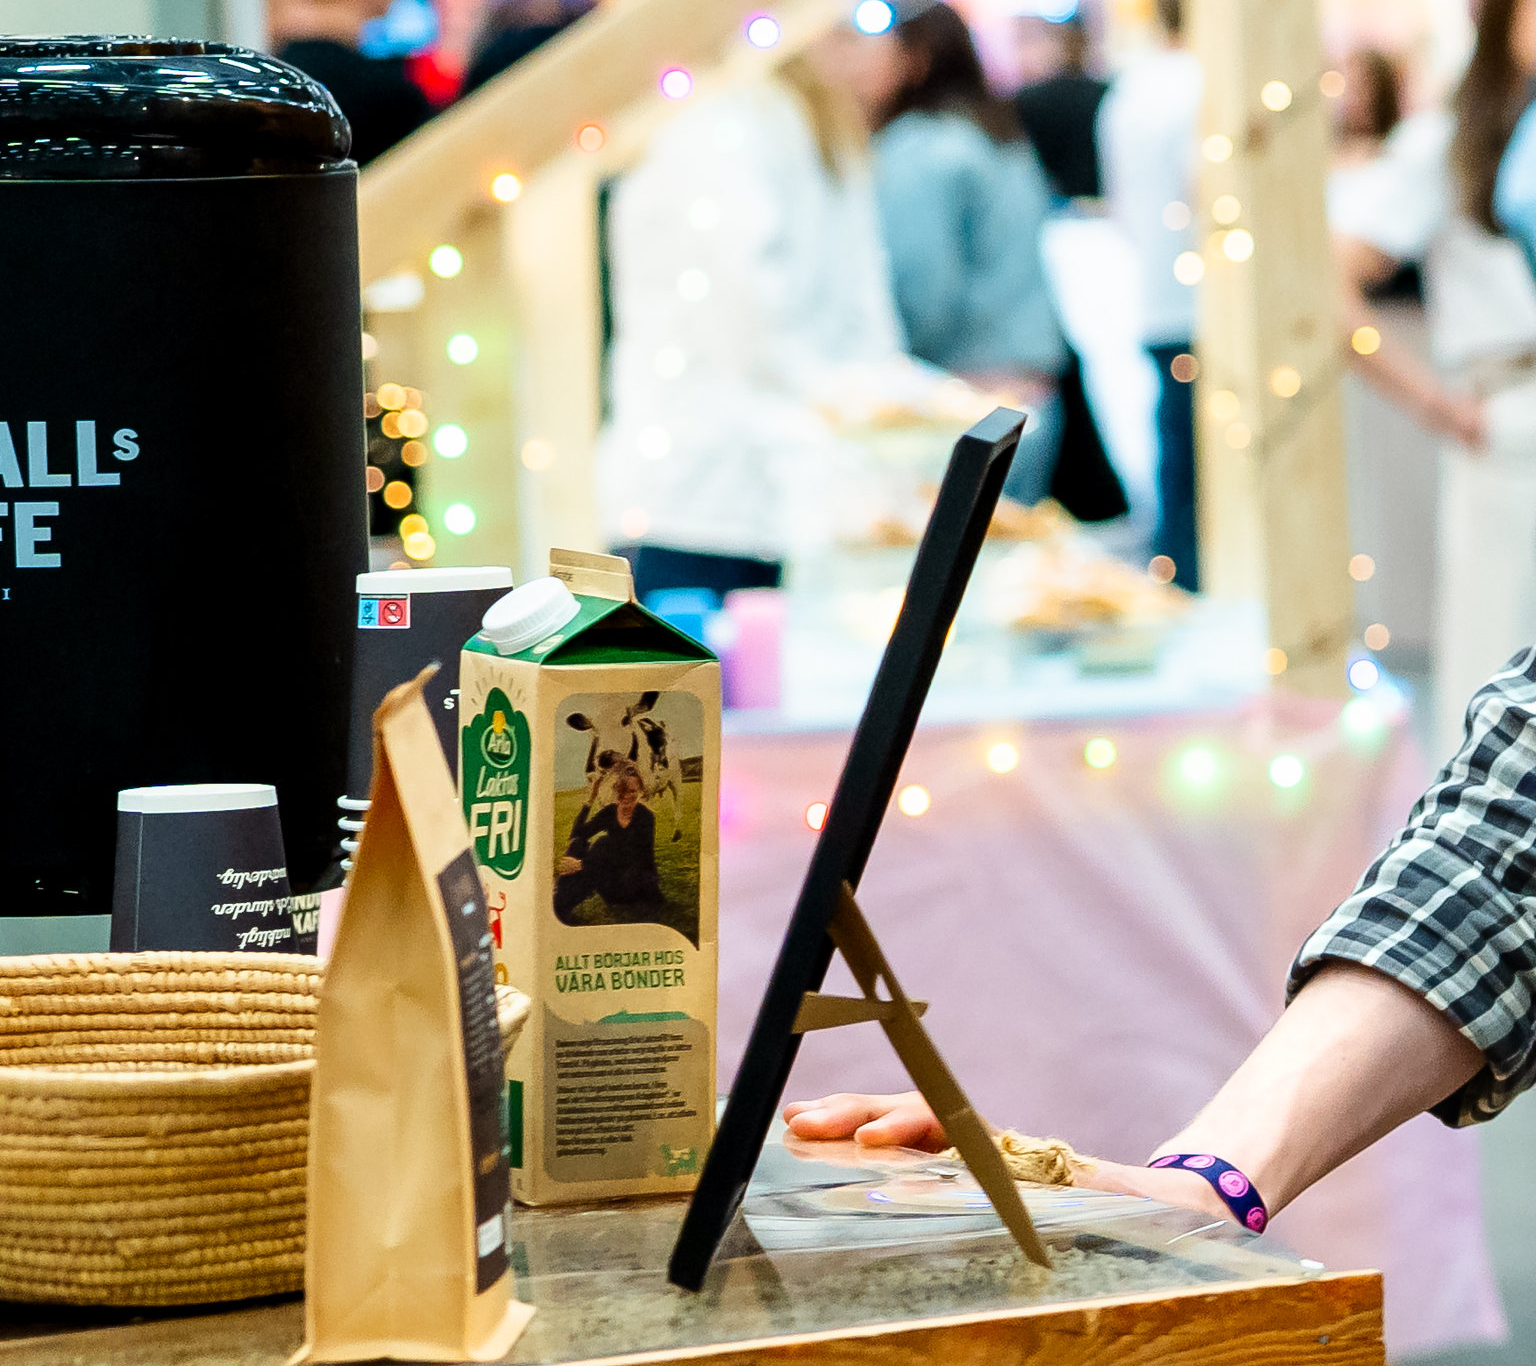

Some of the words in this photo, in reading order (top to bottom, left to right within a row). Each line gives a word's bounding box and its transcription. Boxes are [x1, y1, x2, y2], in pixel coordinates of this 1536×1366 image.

[0, 501, 61, 568] E
[470, 799, 522, 859] FRI
[555, 954, 591, 971] ALLT
[654, 949, 684, 966] HOS
[555, 971, 606, 994] VÅRA
[611, 968, 686, 990] BÖNDER
